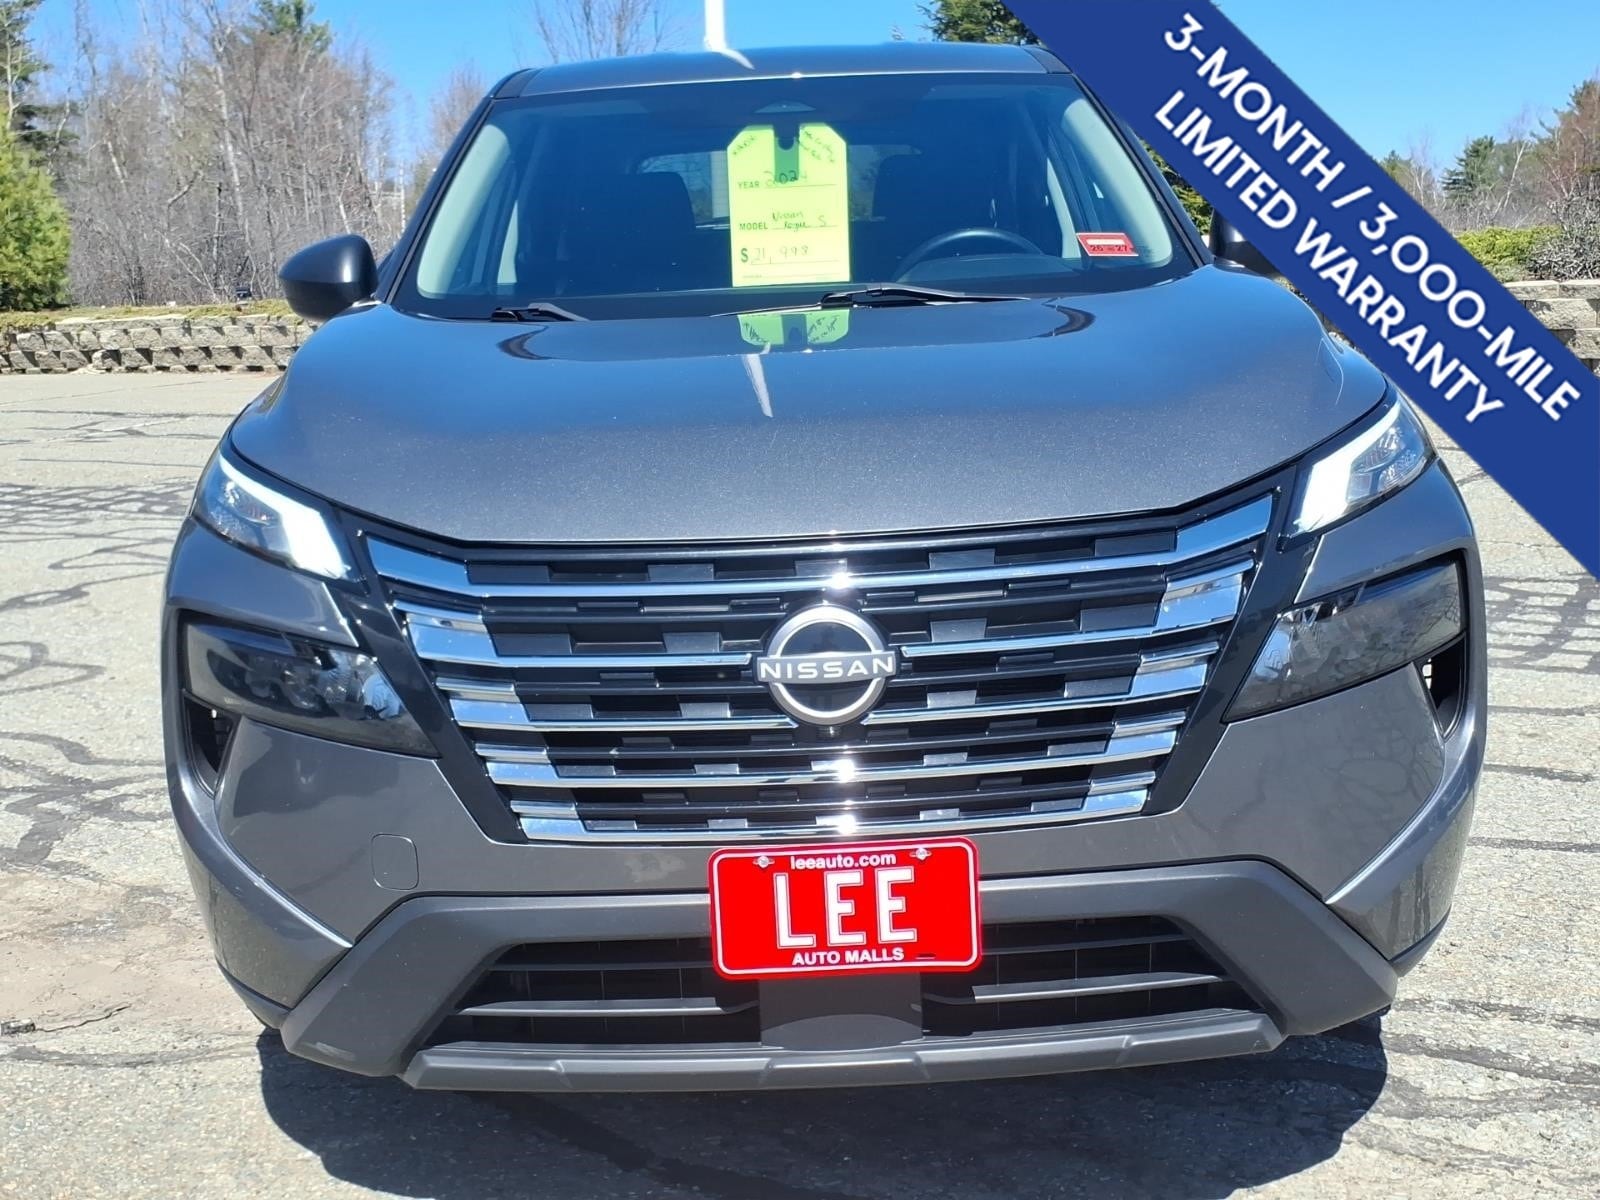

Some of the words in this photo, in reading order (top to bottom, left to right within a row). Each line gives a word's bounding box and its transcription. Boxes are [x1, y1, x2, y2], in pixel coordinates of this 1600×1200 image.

[738, 180, 760, 188] YEAR
[739, 221, 769, 231] MODEL
[760, 656, 893, 679] NISSAN
[790, 852, 897, 871] leeauto.com
[773, 865, 918, 950] LEE
[792, 950, 841, 966] AUTO
[845, 947, 905, 964] MALLS
